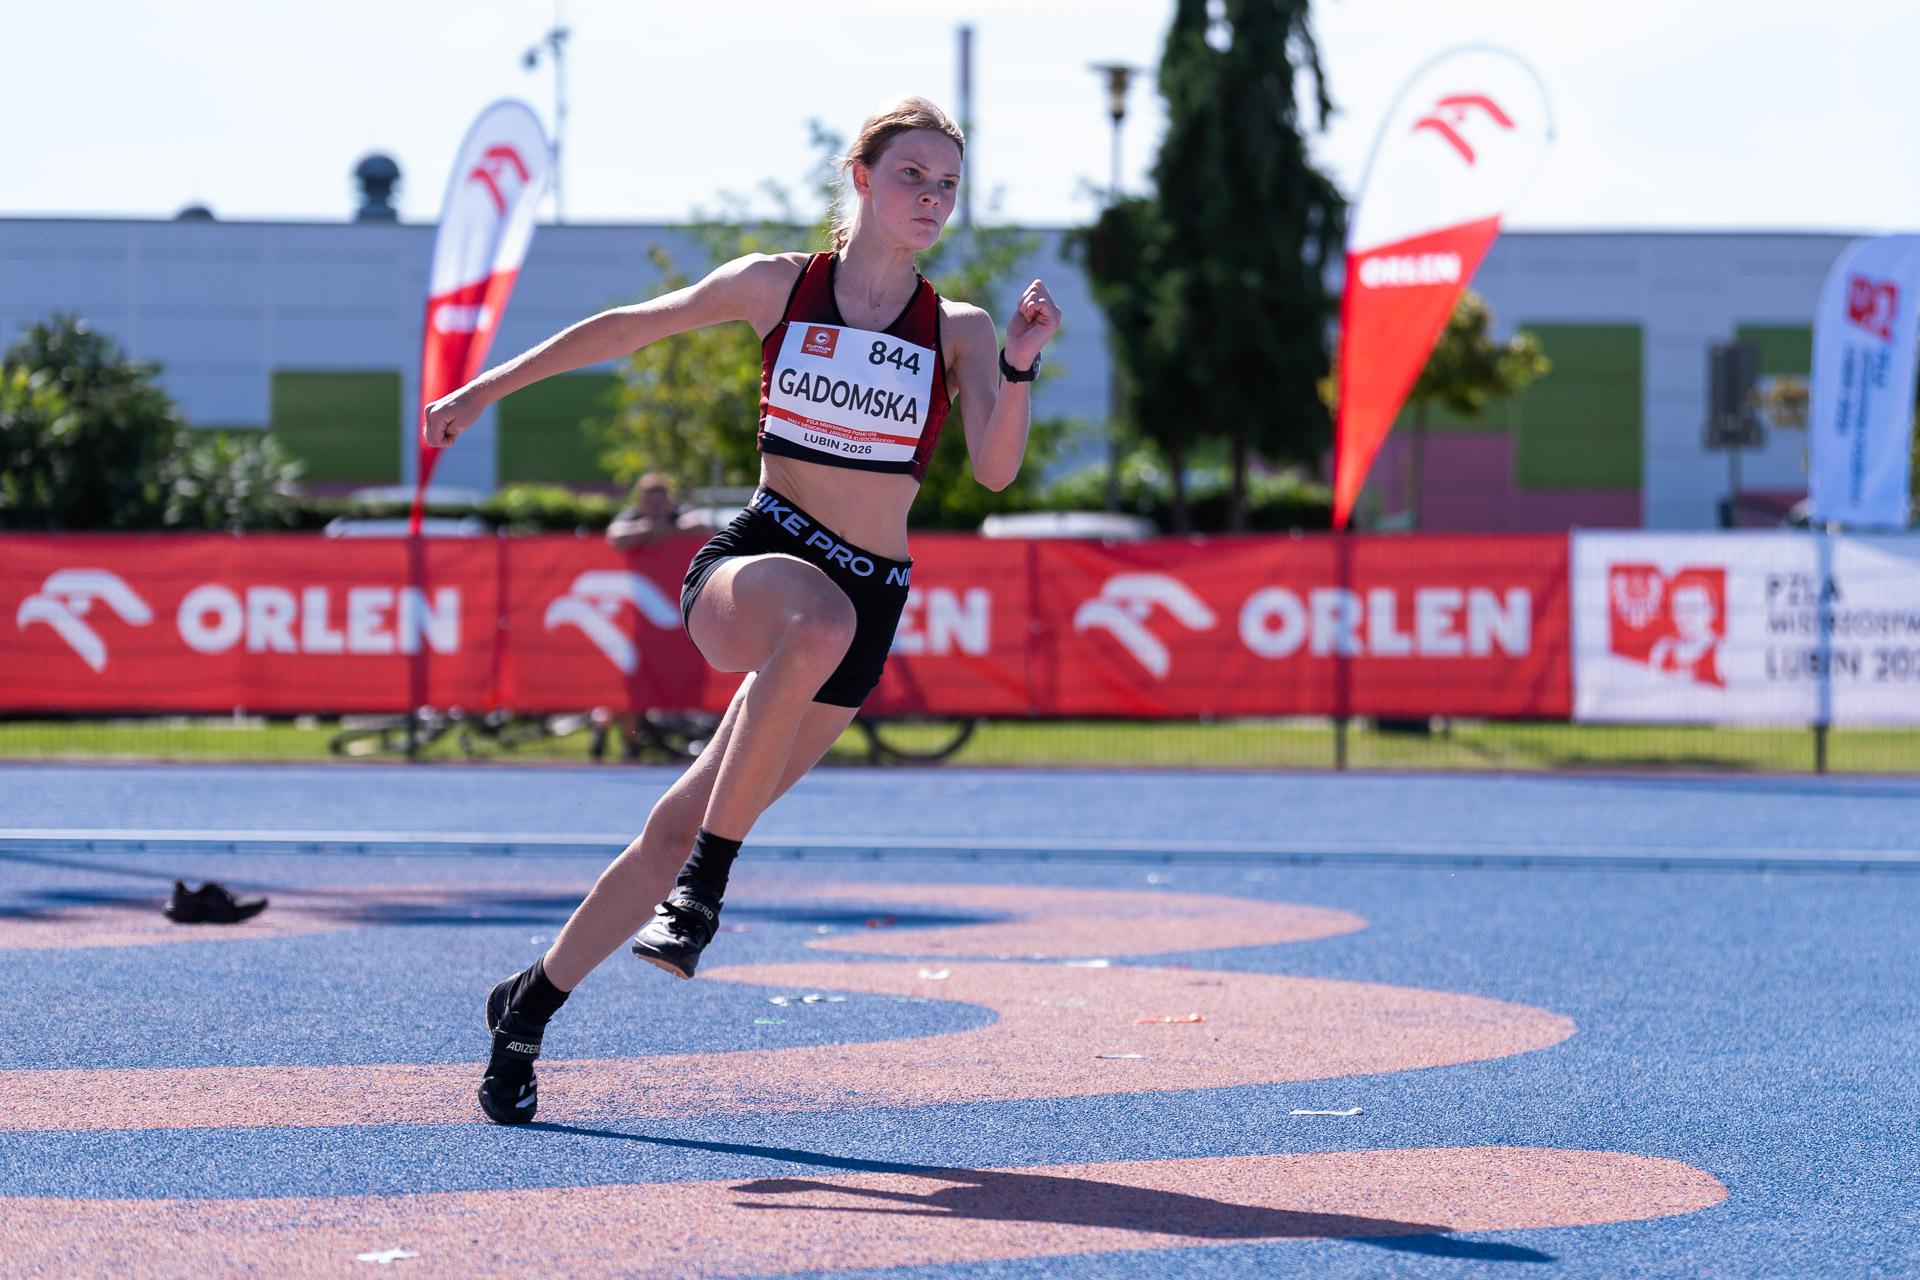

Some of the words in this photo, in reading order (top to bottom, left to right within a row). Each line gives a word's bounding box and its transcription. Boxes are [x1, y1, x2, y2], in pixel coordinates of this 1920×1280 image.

[869, 340, 920, 375] 844
[778, 368, 918, 425] GADOMSKA
[806, 418, 819, 426] PZLA
[828, 429, 853, 440] JANUSZA
[803, 432, 840, 450] LUBIN
[841, 442, 872, 454] 2026
[805, 531, 875, 577] PRO
[885, 567, 910, 587] NI
[177, 584, 459, 655] ORLEN
[1238, 586, 1533, 659] ORLEN
[1766, 648, 1862, 681] LUBIN
[671, 898, 714, 921] ADIZERO
